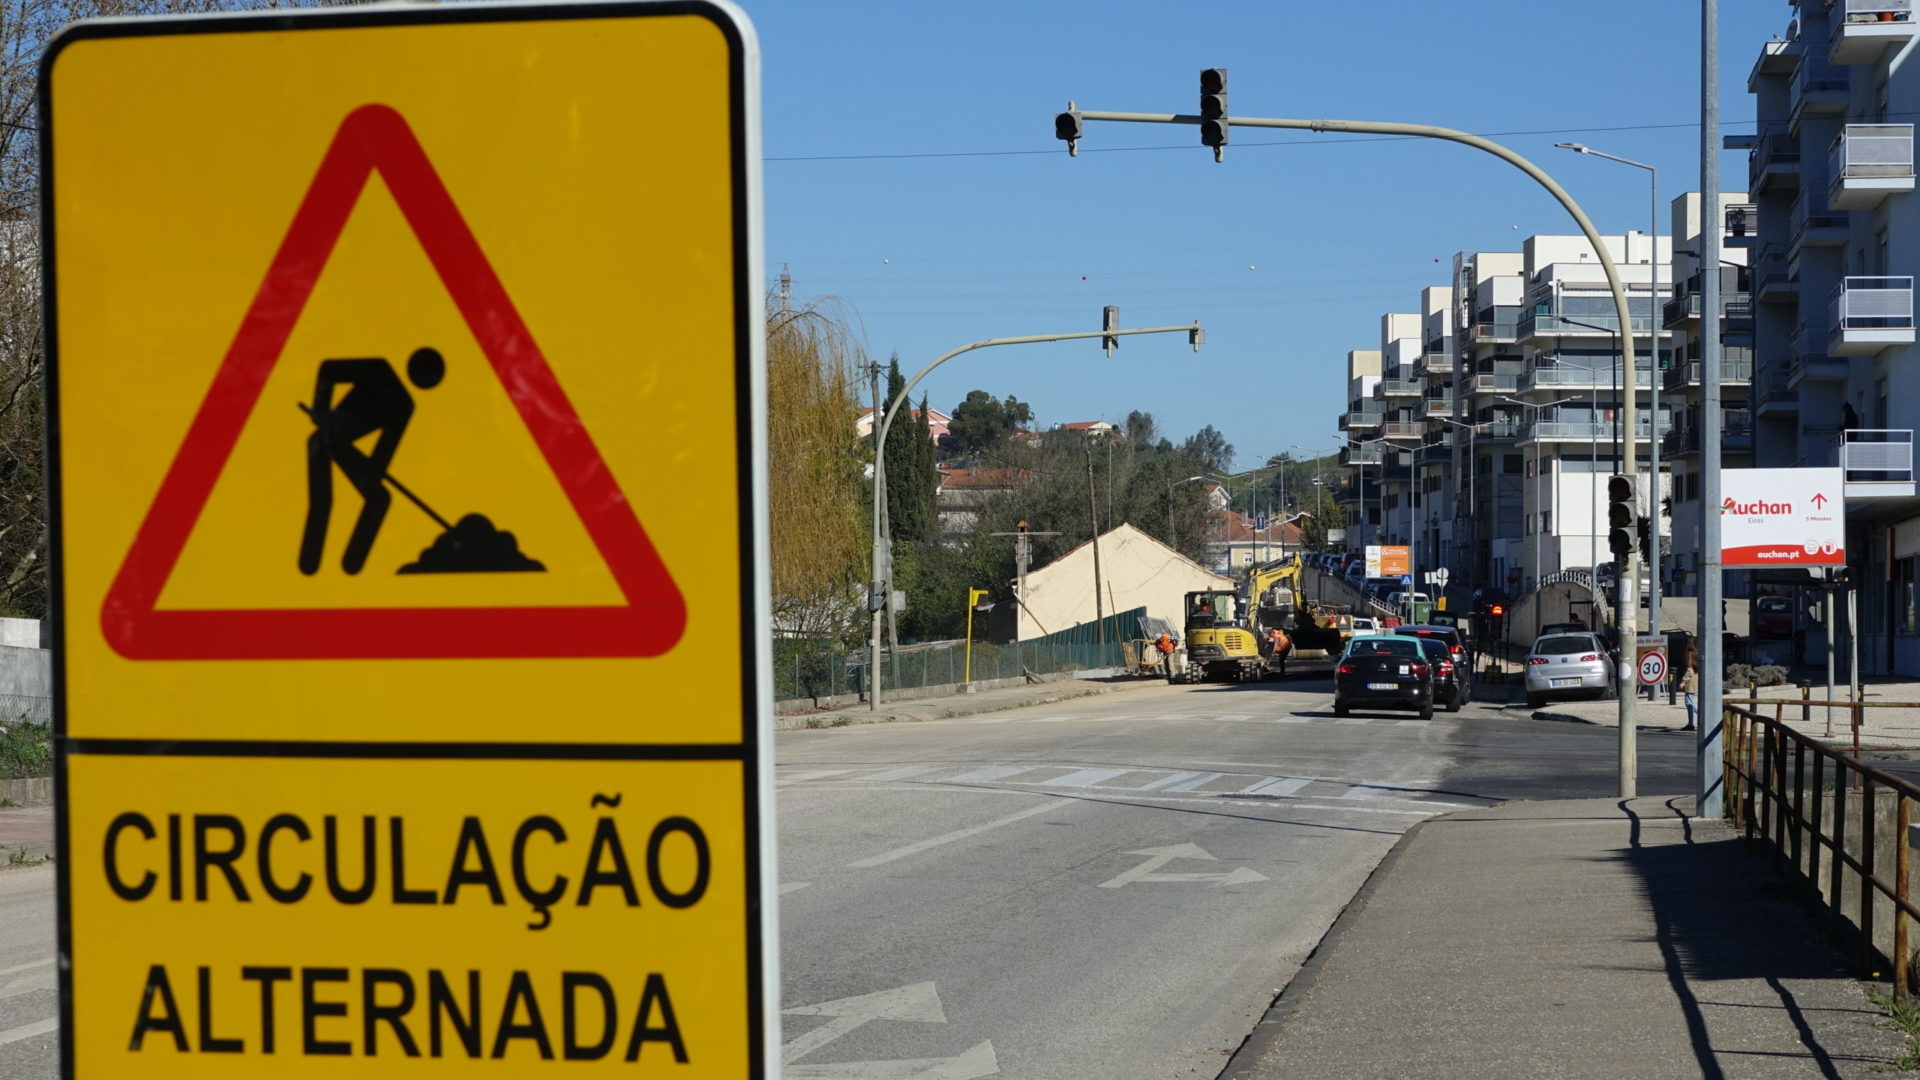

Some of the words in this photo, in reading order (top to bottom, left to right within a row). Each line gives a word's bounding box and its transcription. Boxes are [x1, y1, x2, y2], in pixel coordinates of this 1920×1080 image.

[1720, 497, 1792, 515] Auchan
[1757, 550, 1800, 560] auchan.pt
[1643, 662, 1661, 675] 30
[102, 793, 711, 930] CIRCULAÇÃO
[127, 964, 690, 1064] ALTERNADA
